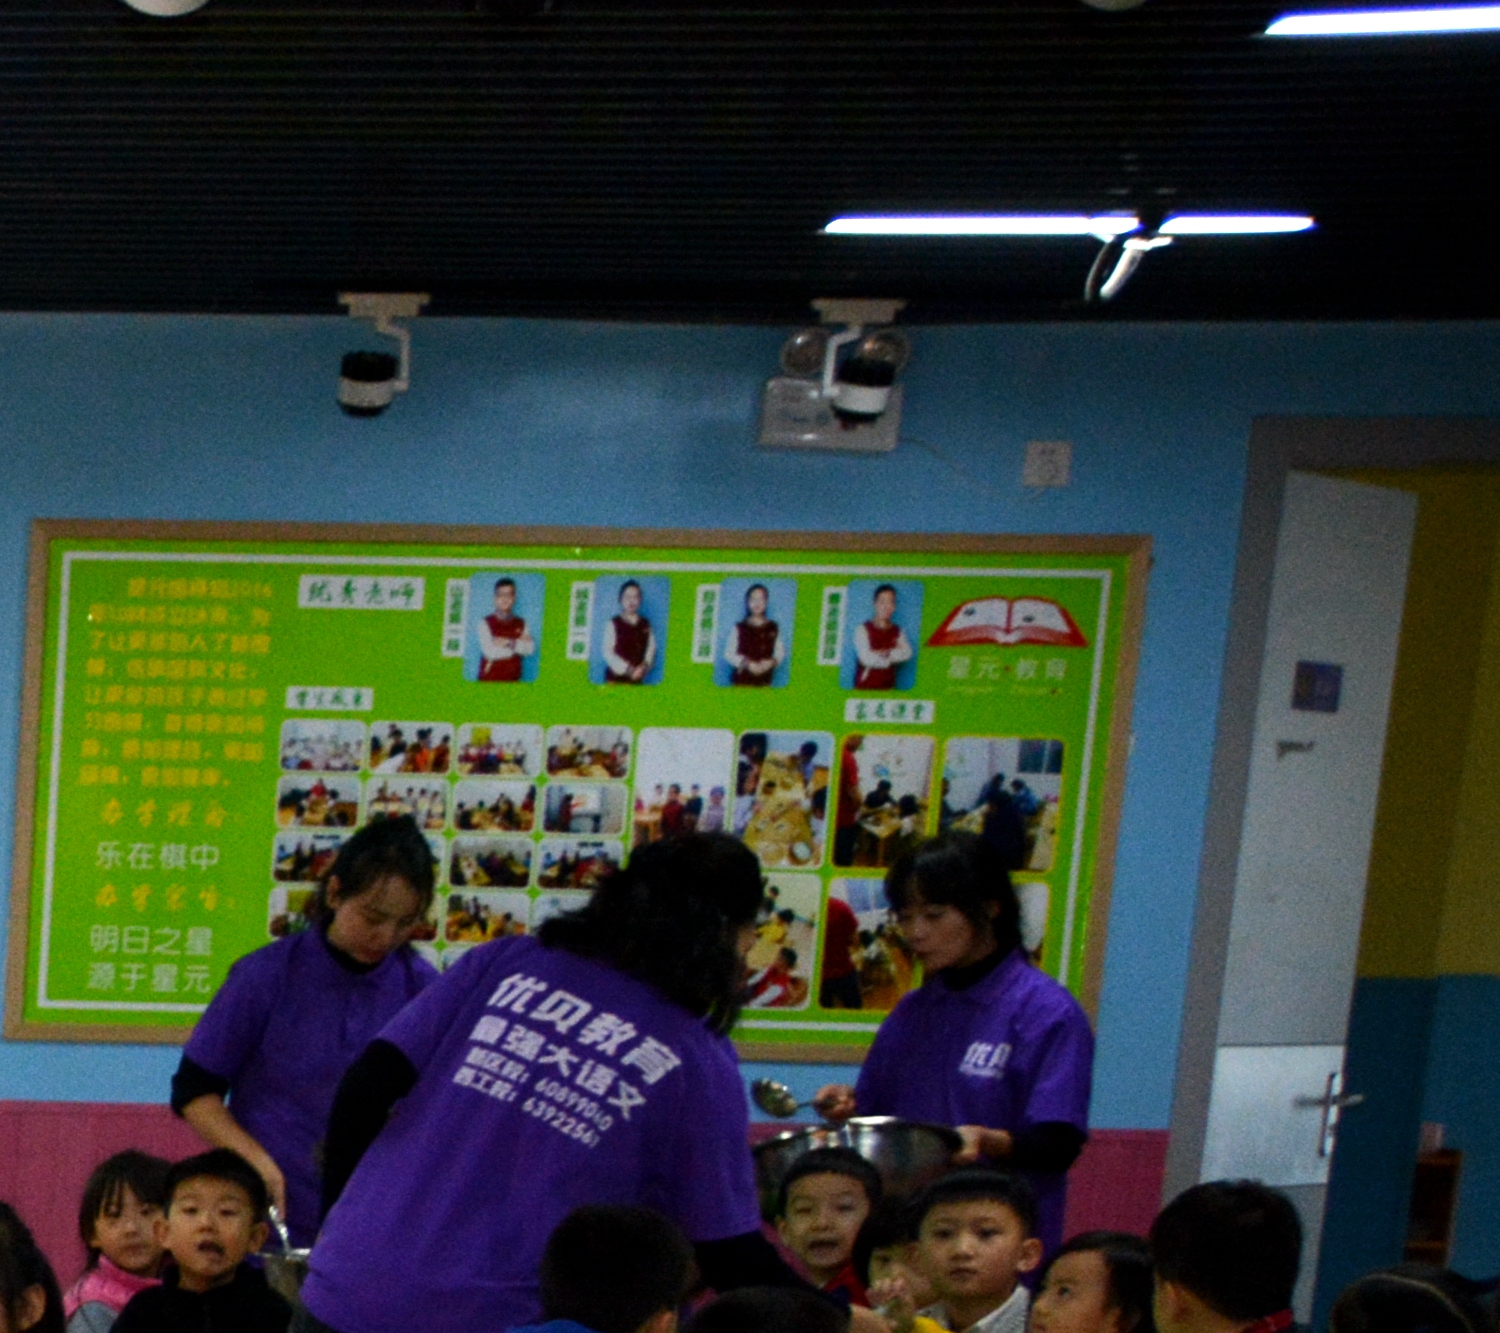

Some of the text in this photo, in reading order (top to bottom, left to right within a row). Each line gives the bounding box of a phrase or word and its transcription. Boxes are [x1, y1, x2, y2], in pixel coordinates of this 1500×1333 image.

[96, 841, 220, 871] 乐在棋中
[90, 924, 213, 956] 明日之星
[87, 961, 211, 993] 源于星元
[487, 973, 682, 1085] 优贝教育
[469, 1014, 647, 1121] 最强大语文
